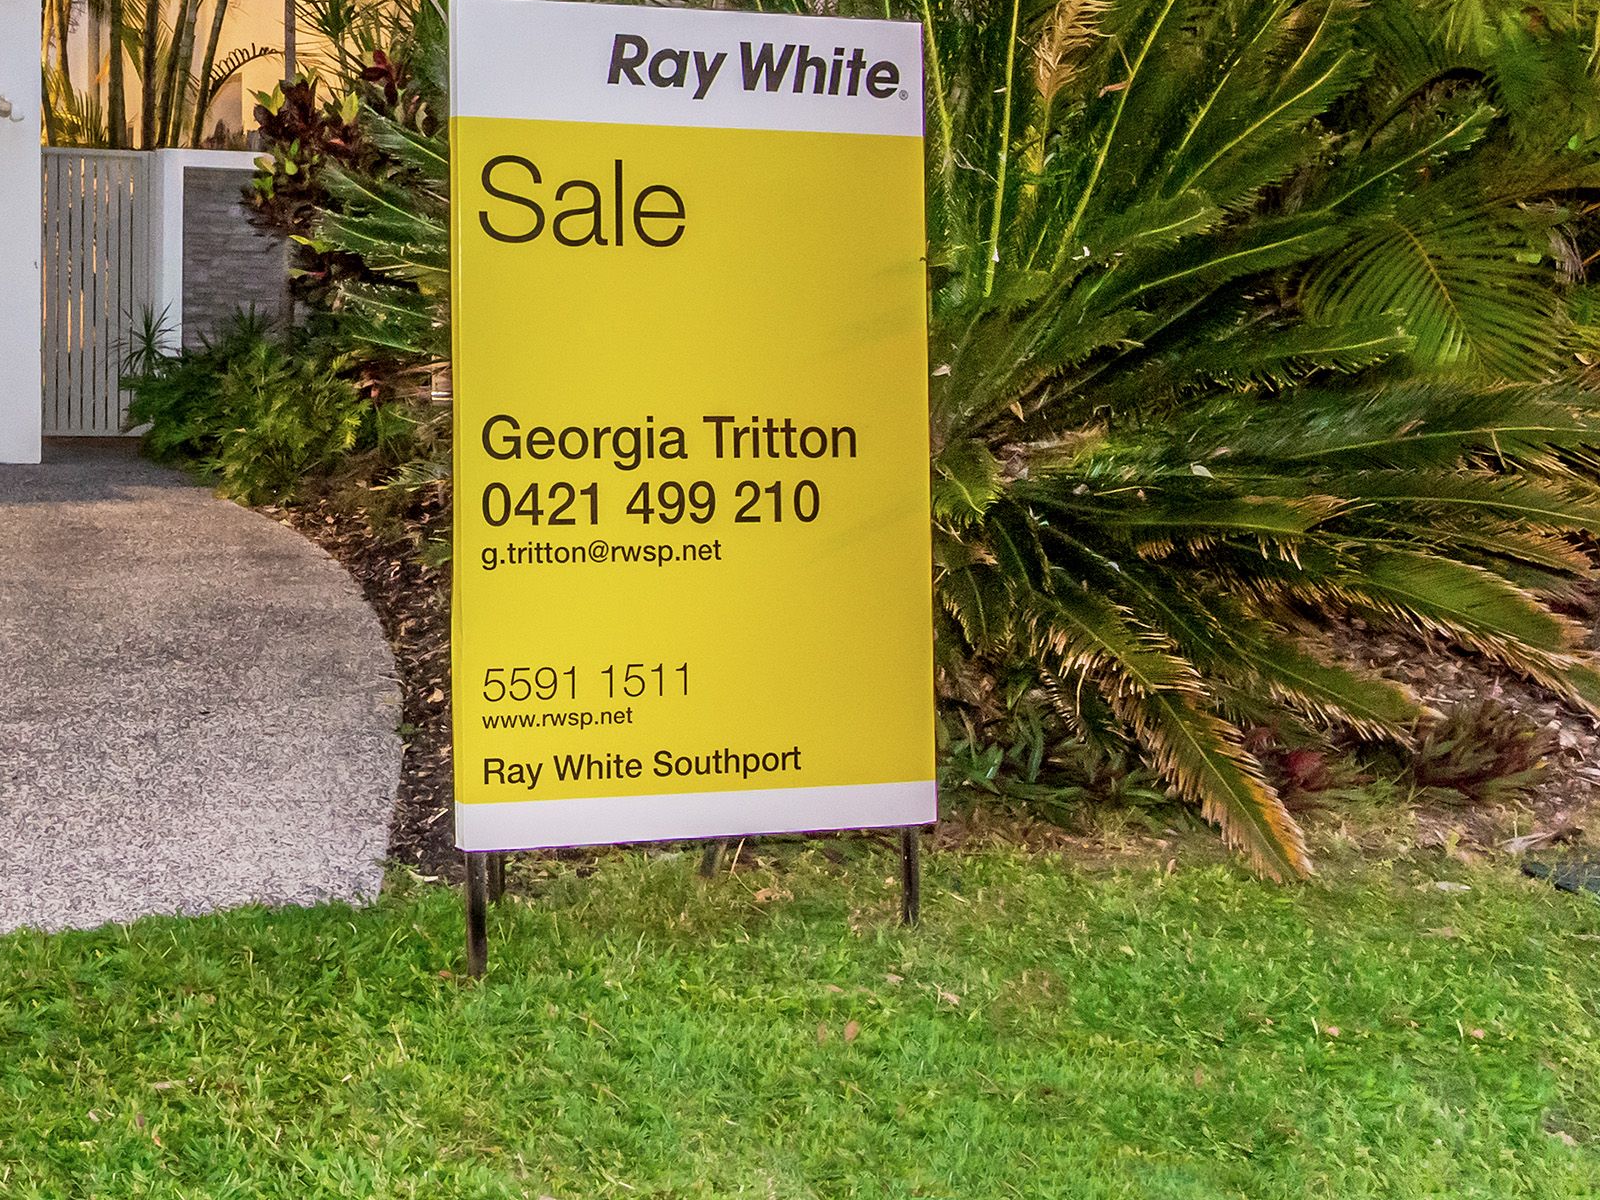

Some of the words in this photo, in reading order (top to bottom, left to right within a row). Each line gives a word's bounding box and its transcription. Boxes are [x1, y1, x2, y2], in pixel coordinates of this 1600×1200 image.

[606, 33, 729, 100] Ray
[478, 154, 686, 248] Sale
[481, 414, 689, 472] Georgia
[702, 415, 857, 459] Tritton
[481, 481, 599, 527] 0421
[625, 480, 716, 525] 499
[734, 479, 820, 524] 210
[481, 539, 722, 571] g.tritton@rwsp.net
[482, 665, 576, 703] 5591
[600, 662, 688, 699] 1511
[481, 706, 633, 731] www.rwsp.net
[483, 757, 544, 791] Ray
[552, 752, 643, 782] White
[652, 745, 802, 780] Southport
